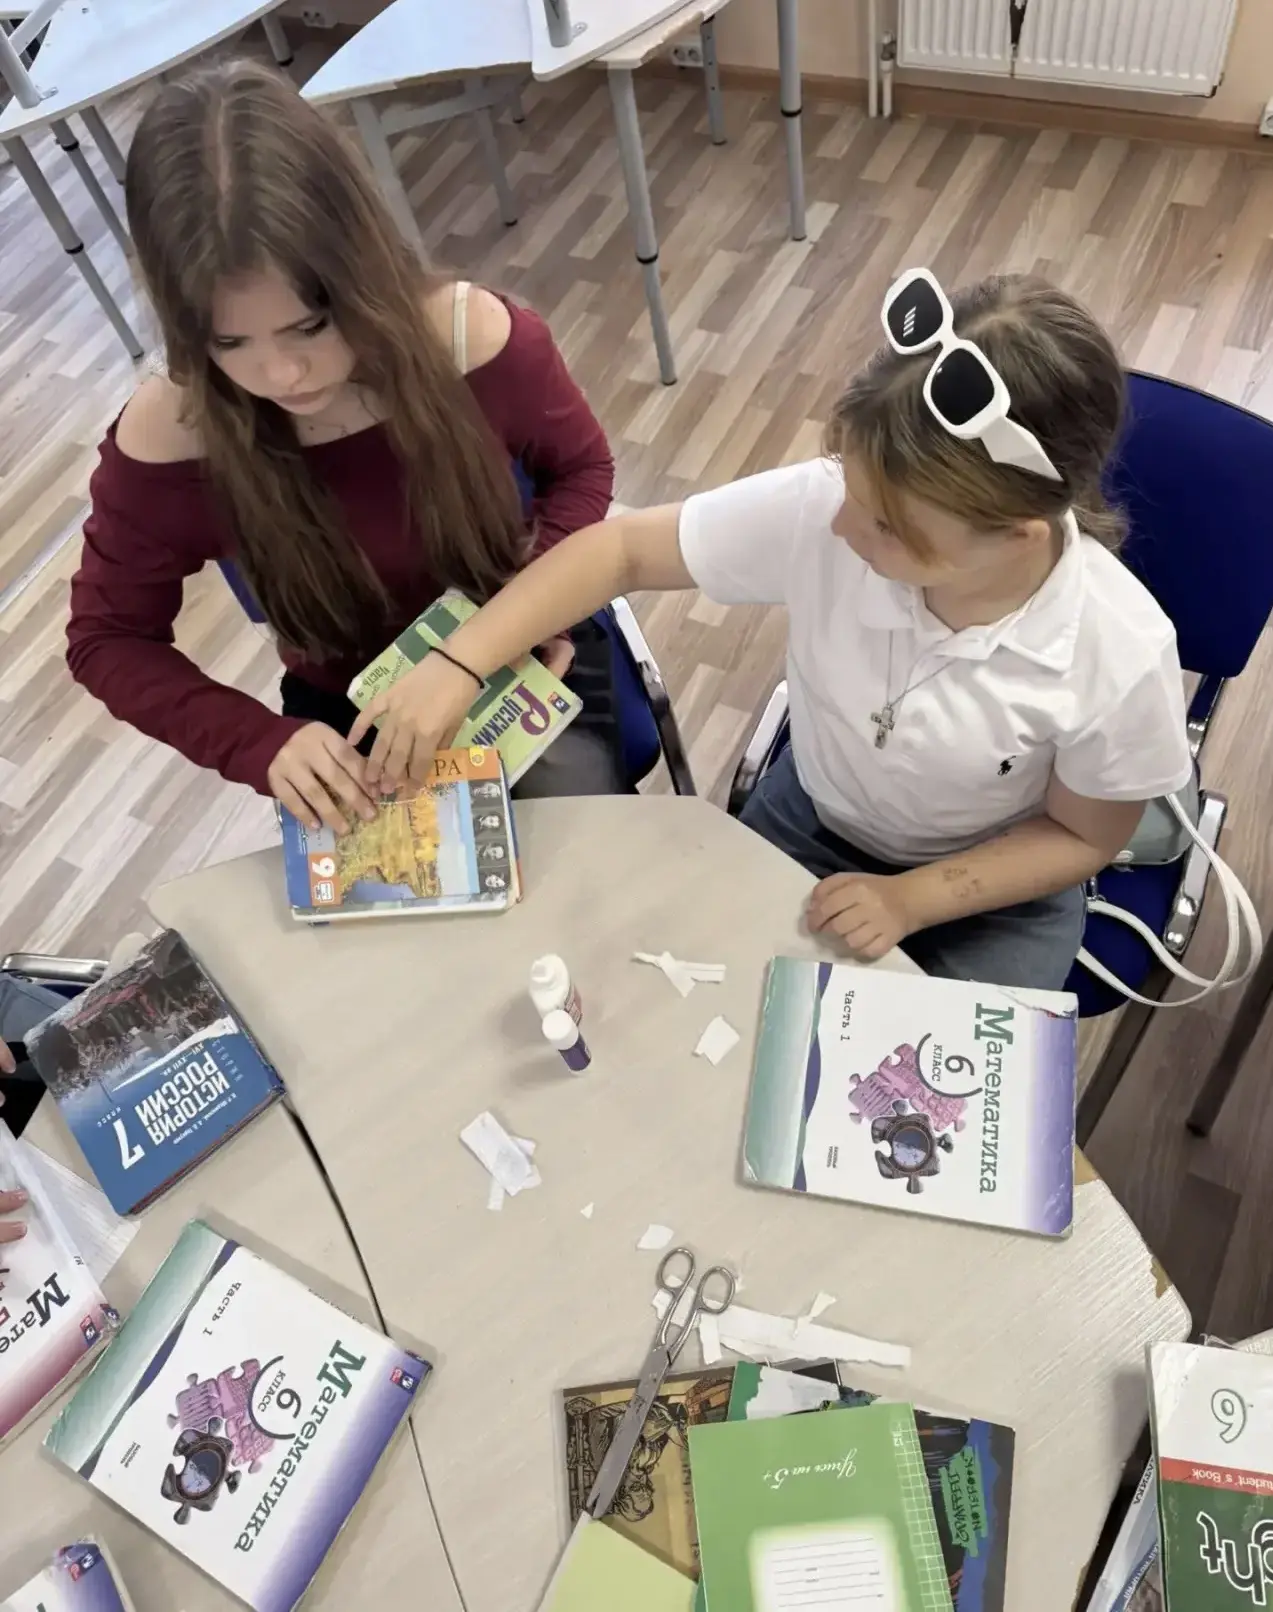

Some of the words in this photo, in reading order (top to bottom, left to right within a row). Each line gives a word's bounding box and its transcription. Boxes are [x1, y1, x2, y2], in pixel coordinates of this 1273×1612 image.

[312, 857, 335, 878] 9
[944, 1054, 975, 1076] 6
[134, 1051, 219, 1127] РОССИИ
[974, 1003, 1015, 1194] Математика
[147, 1071, 231, 1146] ИСТОРИЯ
[112, 1118, 146, 1170] 7
[202, 1327, 213, 1336] 1
[276, 1388, 302, 1419] 6
[1210, 1388, 1247, 1443] 6
[234, 1339, 367, 1552] Математика
[792, 1464, 811, 1476] на
[814, 1447, 858, 1480] Учись
[1192, 1466, 1222, 1484] Book
